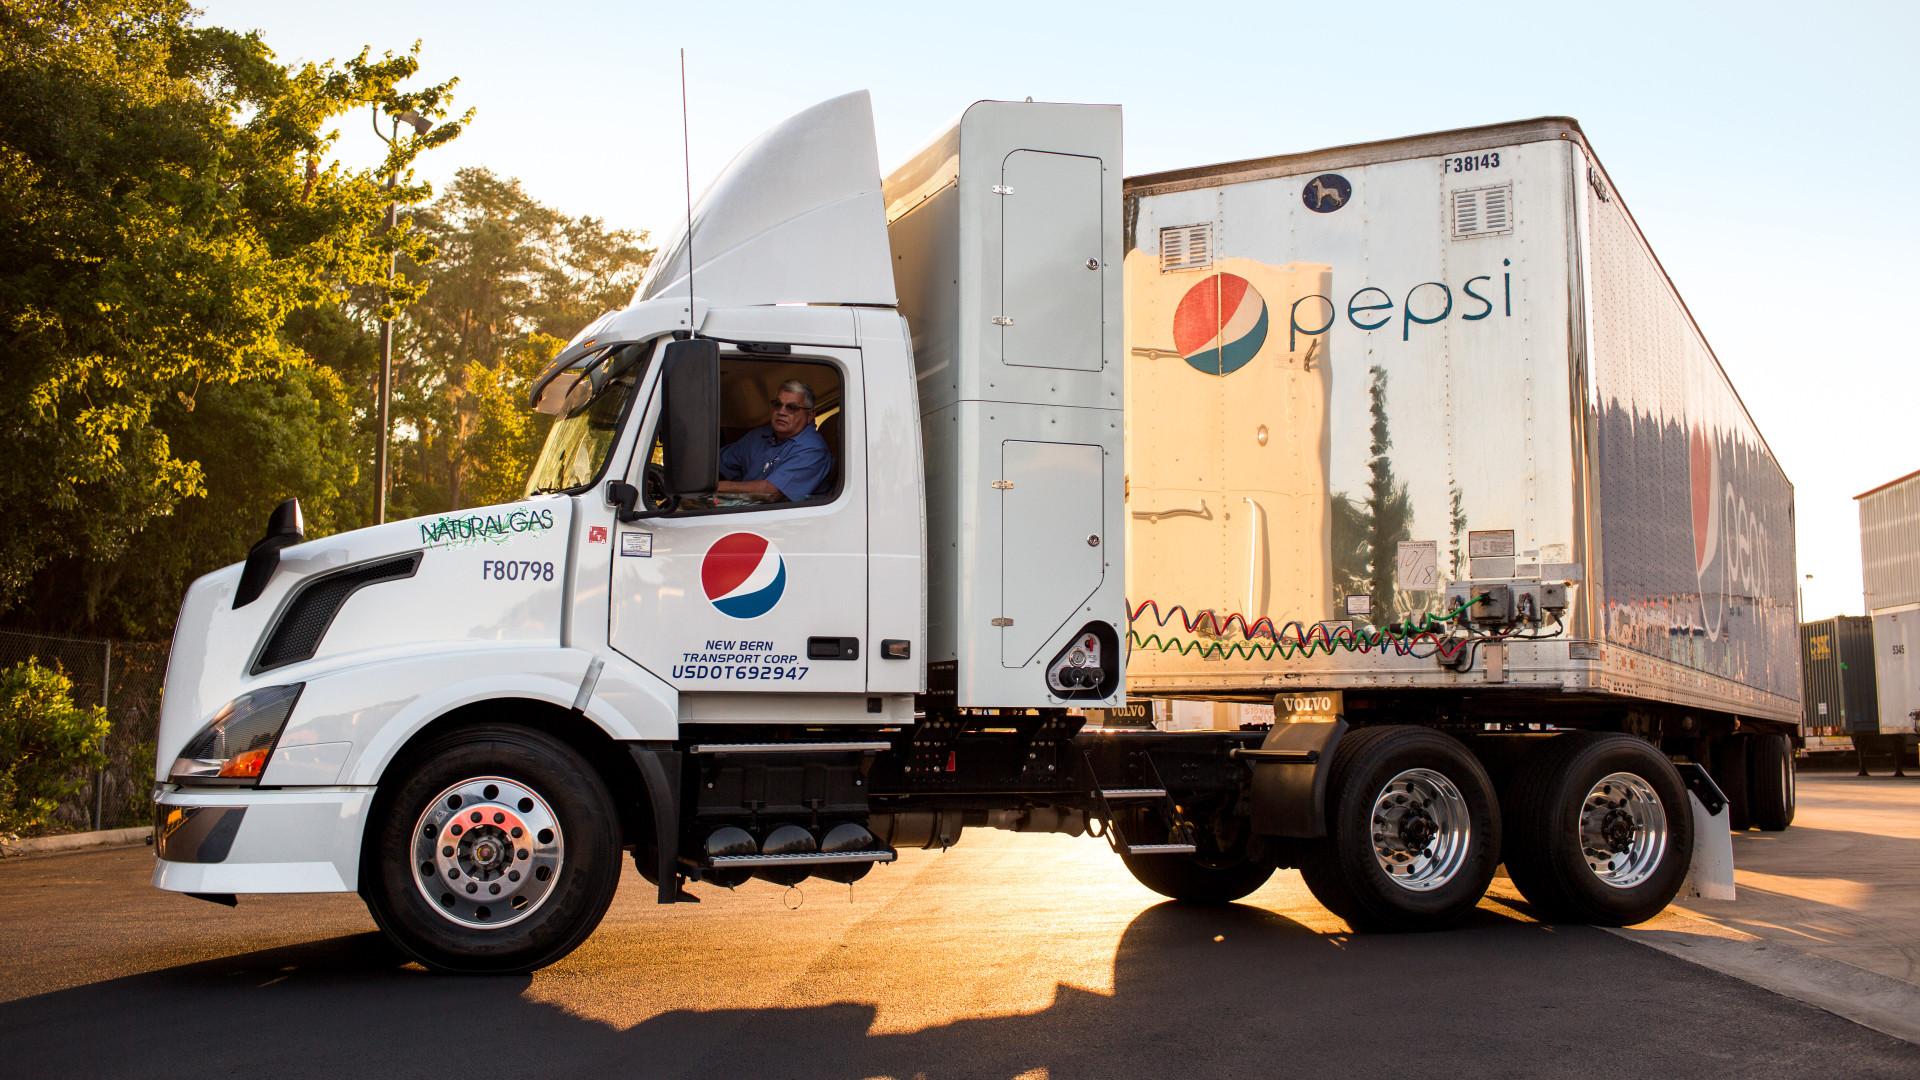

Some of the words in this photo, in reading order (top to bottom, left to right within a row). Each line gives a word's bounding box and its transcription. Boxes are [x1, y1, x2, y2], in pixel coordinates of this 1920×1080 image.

[1444, 152, 1501, 174] F38143
[1290, 258, 1512, 352] pepsi
[483, 560, 554, 581] F80798
[705, 640, 737, 651] NEW
[739, 640, 774, 651] BERN
[683, 653, 759, 664] TRANSPORT
[763, 654, 800, 665] CORP.
[672, 665, 809, 681] USDOT692947
[1111, 704, 1146, 717] VOLVO
[1282, 696, 1331, 712] VOLVO
